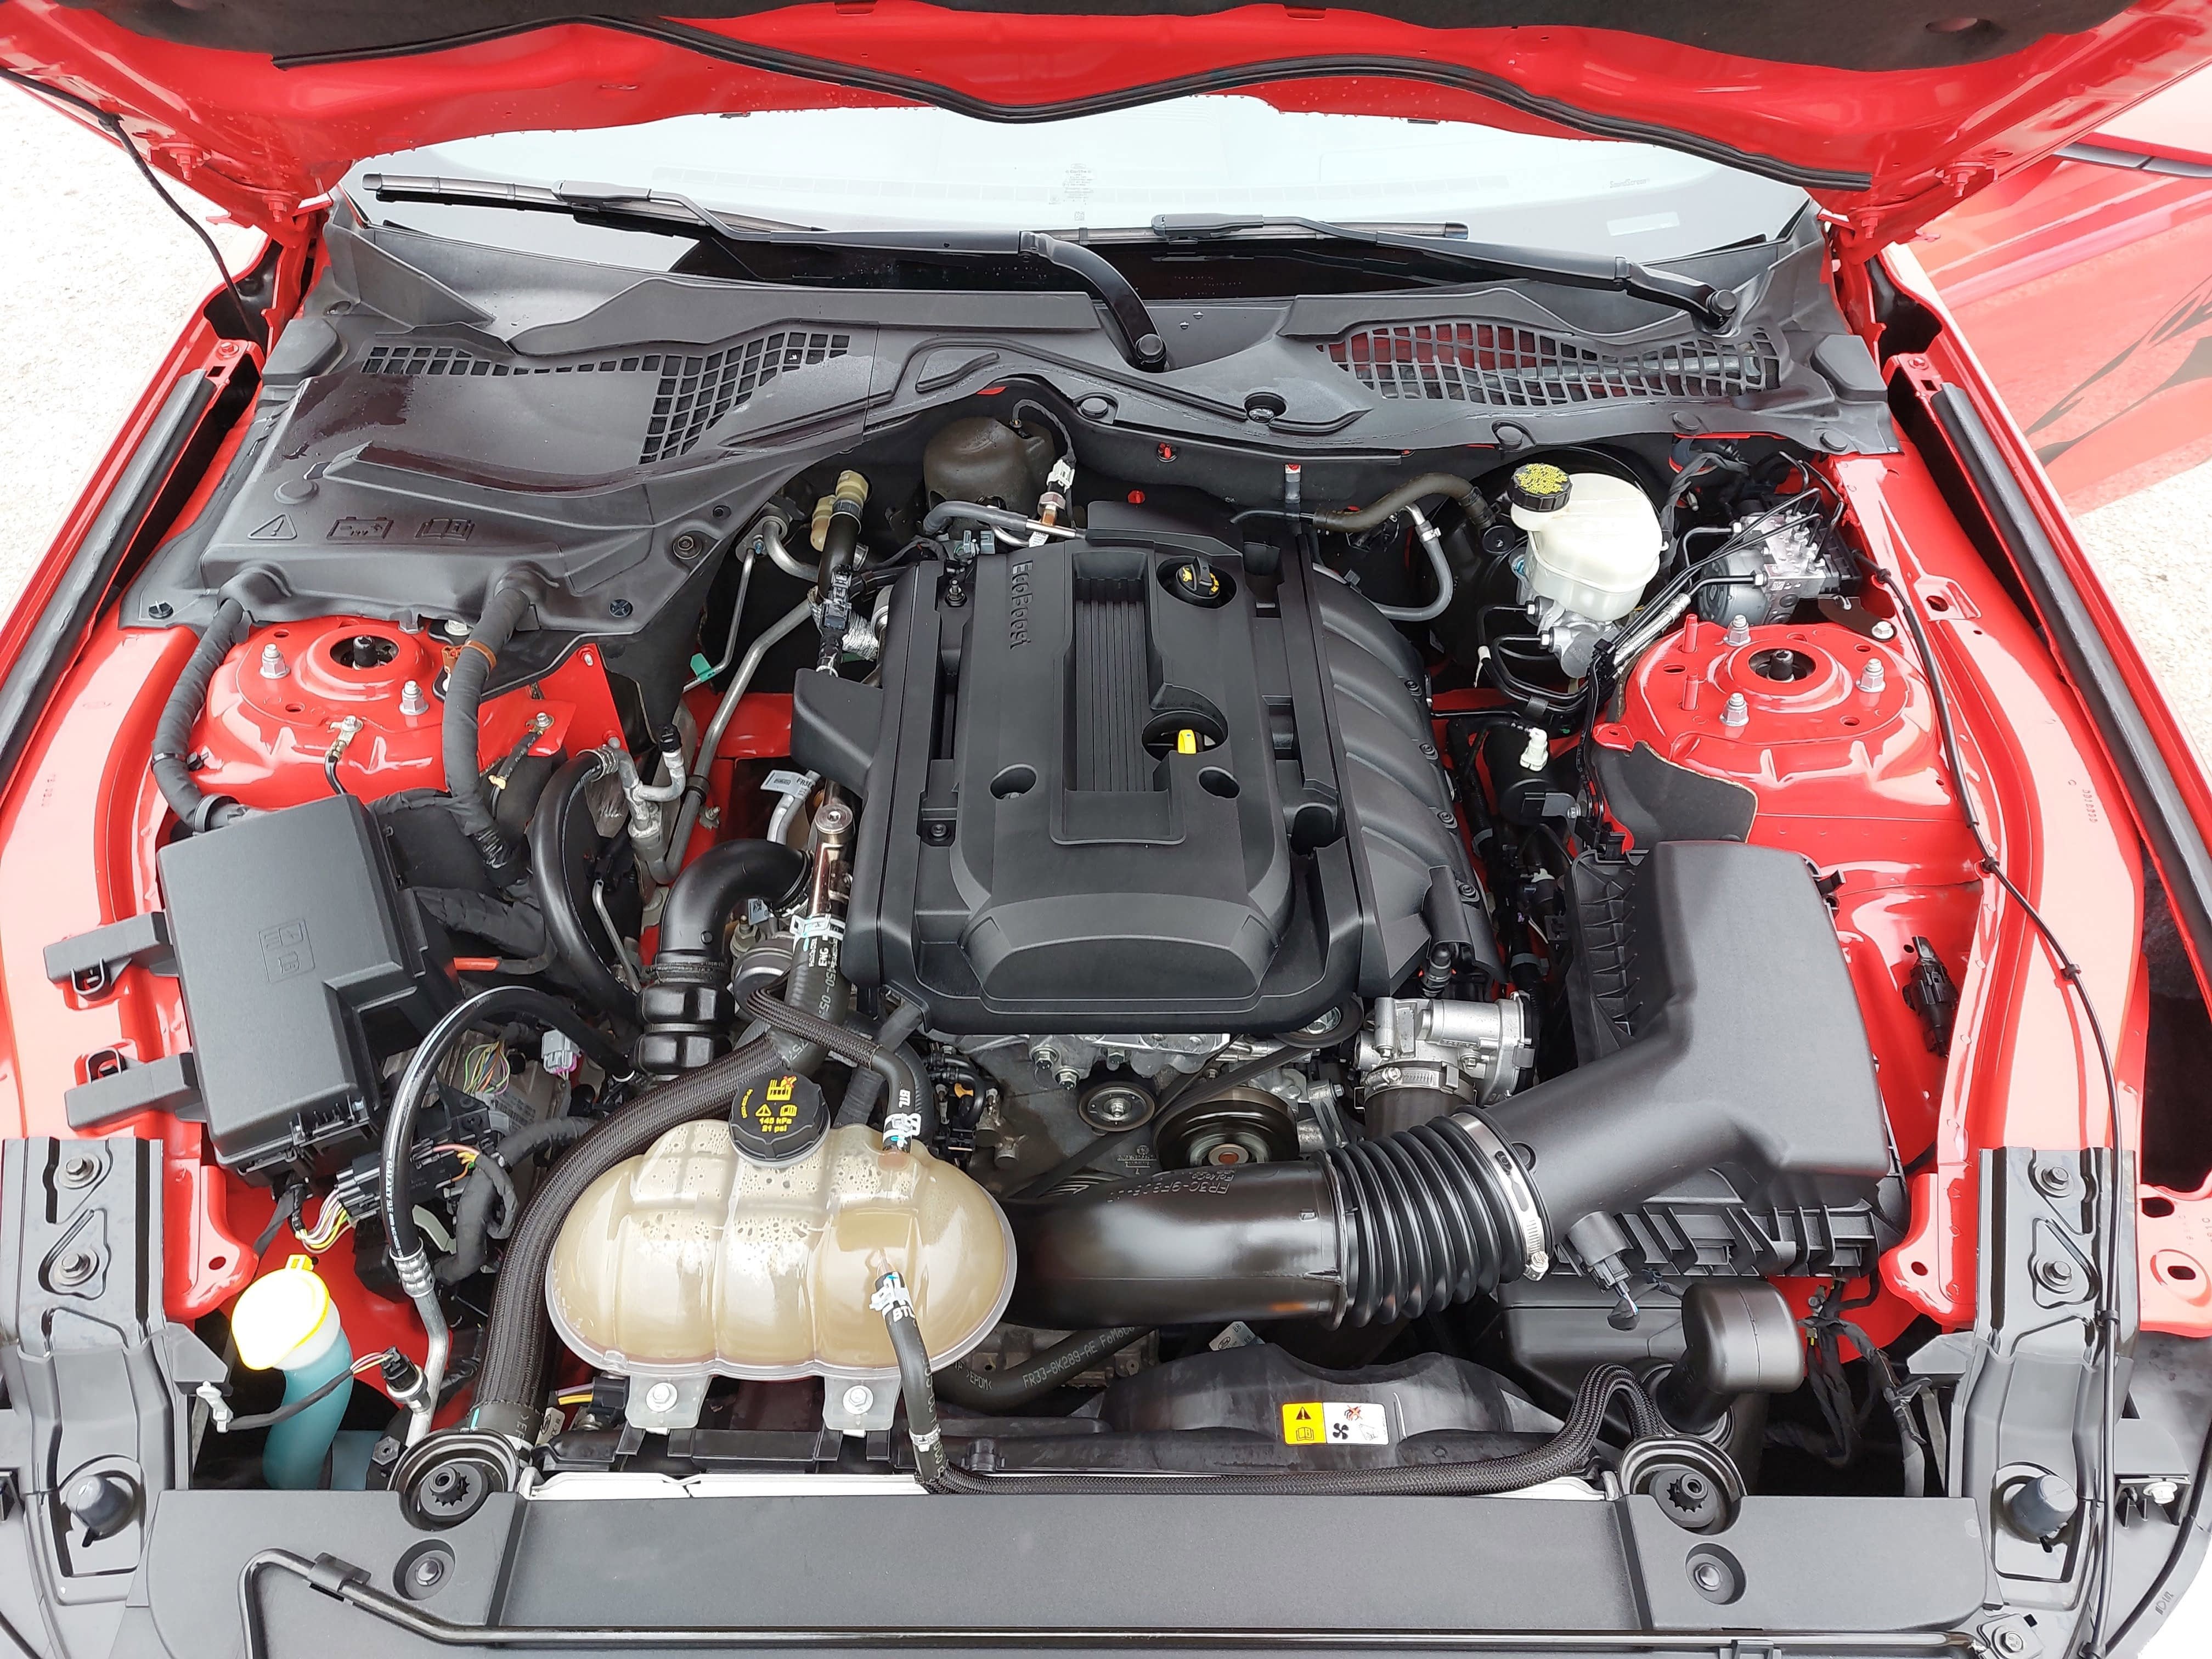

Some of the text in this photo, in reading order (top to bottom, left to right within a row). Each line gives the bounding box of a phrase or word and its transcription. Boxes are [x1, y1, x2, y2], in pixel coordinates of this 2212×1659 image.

[1010, 560, 1033, 650] EcoBoost
[818, 947, 829, 967] ENG
[774, 1125, 787, 1133] psi
[385, 1160, 393, 1199] GALAXY
[1022, 1341, 1098, 1389] FR33-8K289-AE
